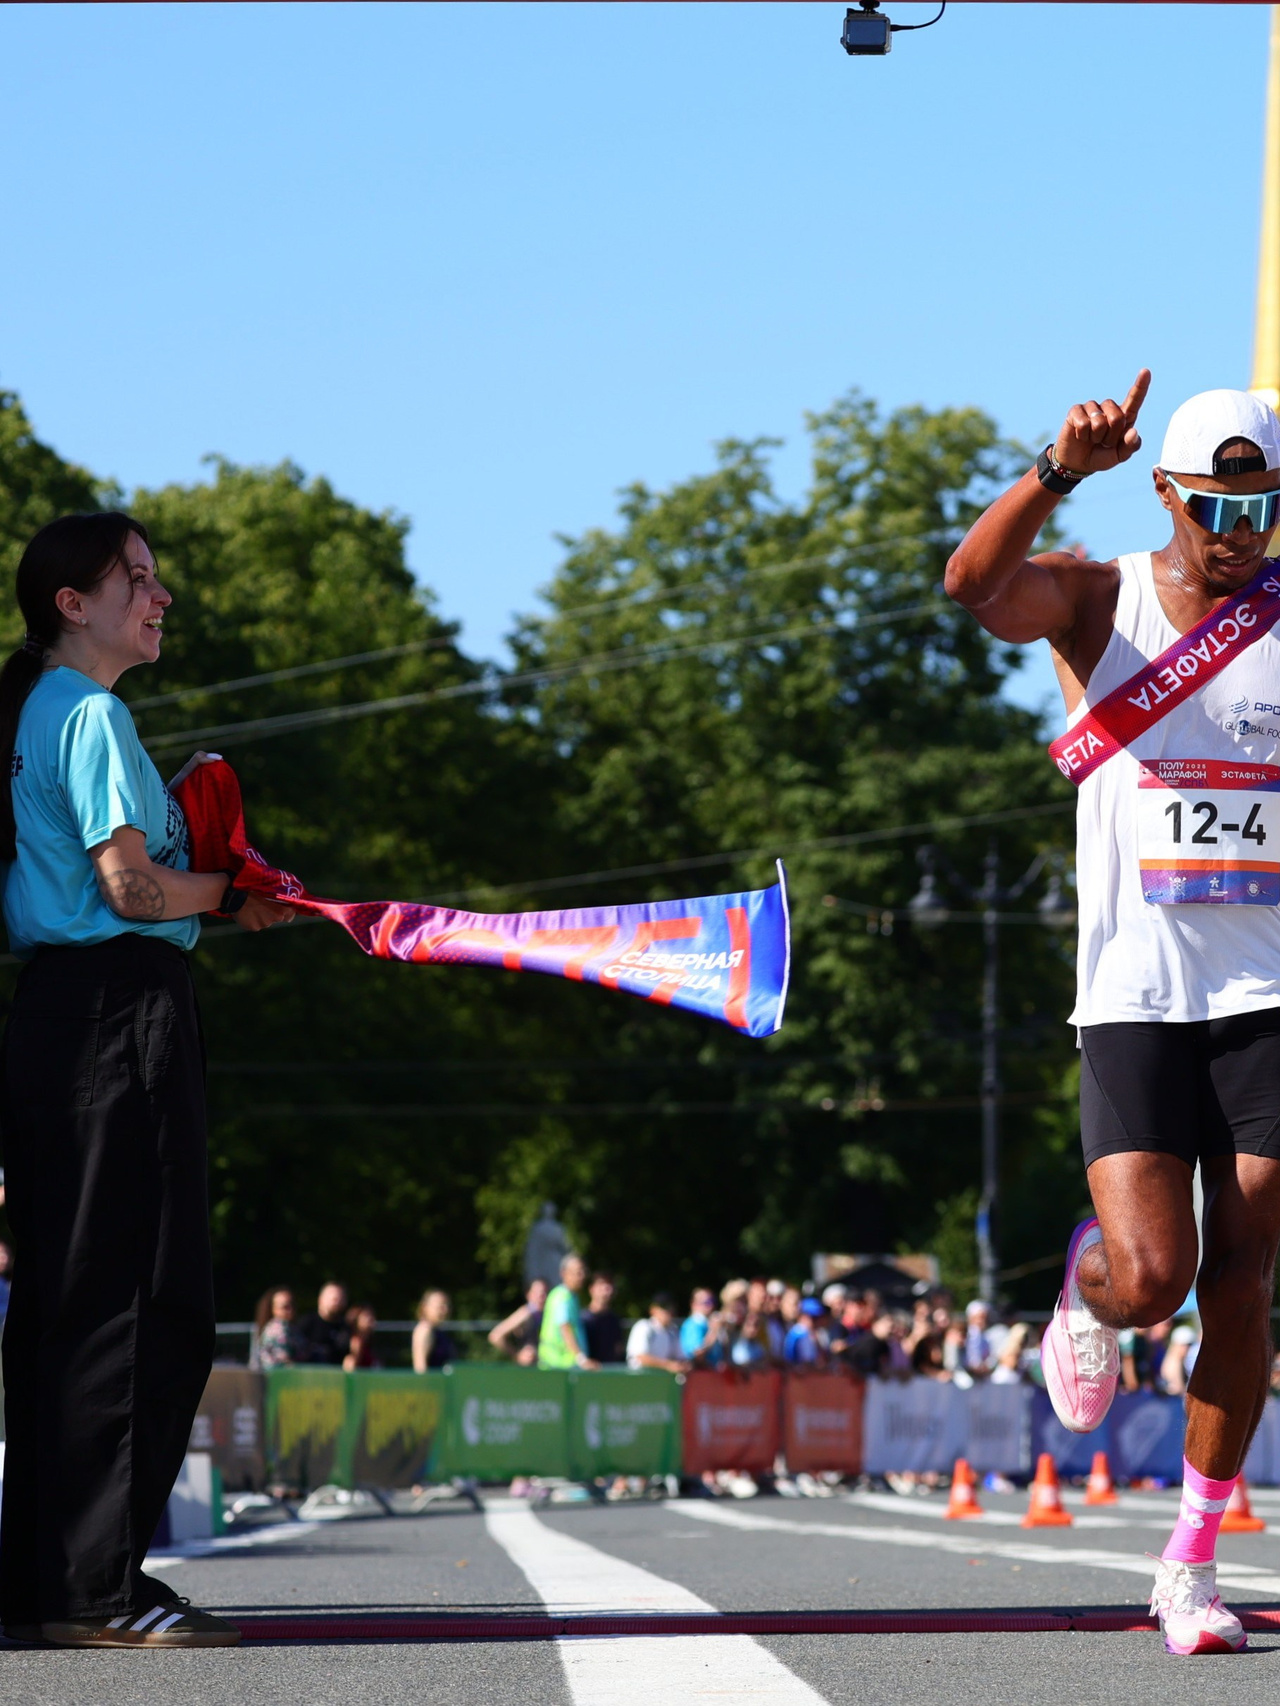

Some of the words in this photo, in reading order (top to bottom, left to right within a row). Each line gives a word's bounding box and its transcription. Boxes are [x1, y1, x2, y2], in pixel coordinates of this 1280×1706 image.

[1127, 603, 1258, 712] ЭСТАФЕТА
[1158, 770, 1207, 779] МАРАФОН
[1159, 762, 1185, 770] ПОЛУ
[1221, 770, 1267, 781] ЭСТАФЕТА
[1165, 801, 1267, 846] 12-4
[619, 950, 745, 970] СЕВЕРНАЯ
[604, 965, 721, 990] СТОЛИЦА
